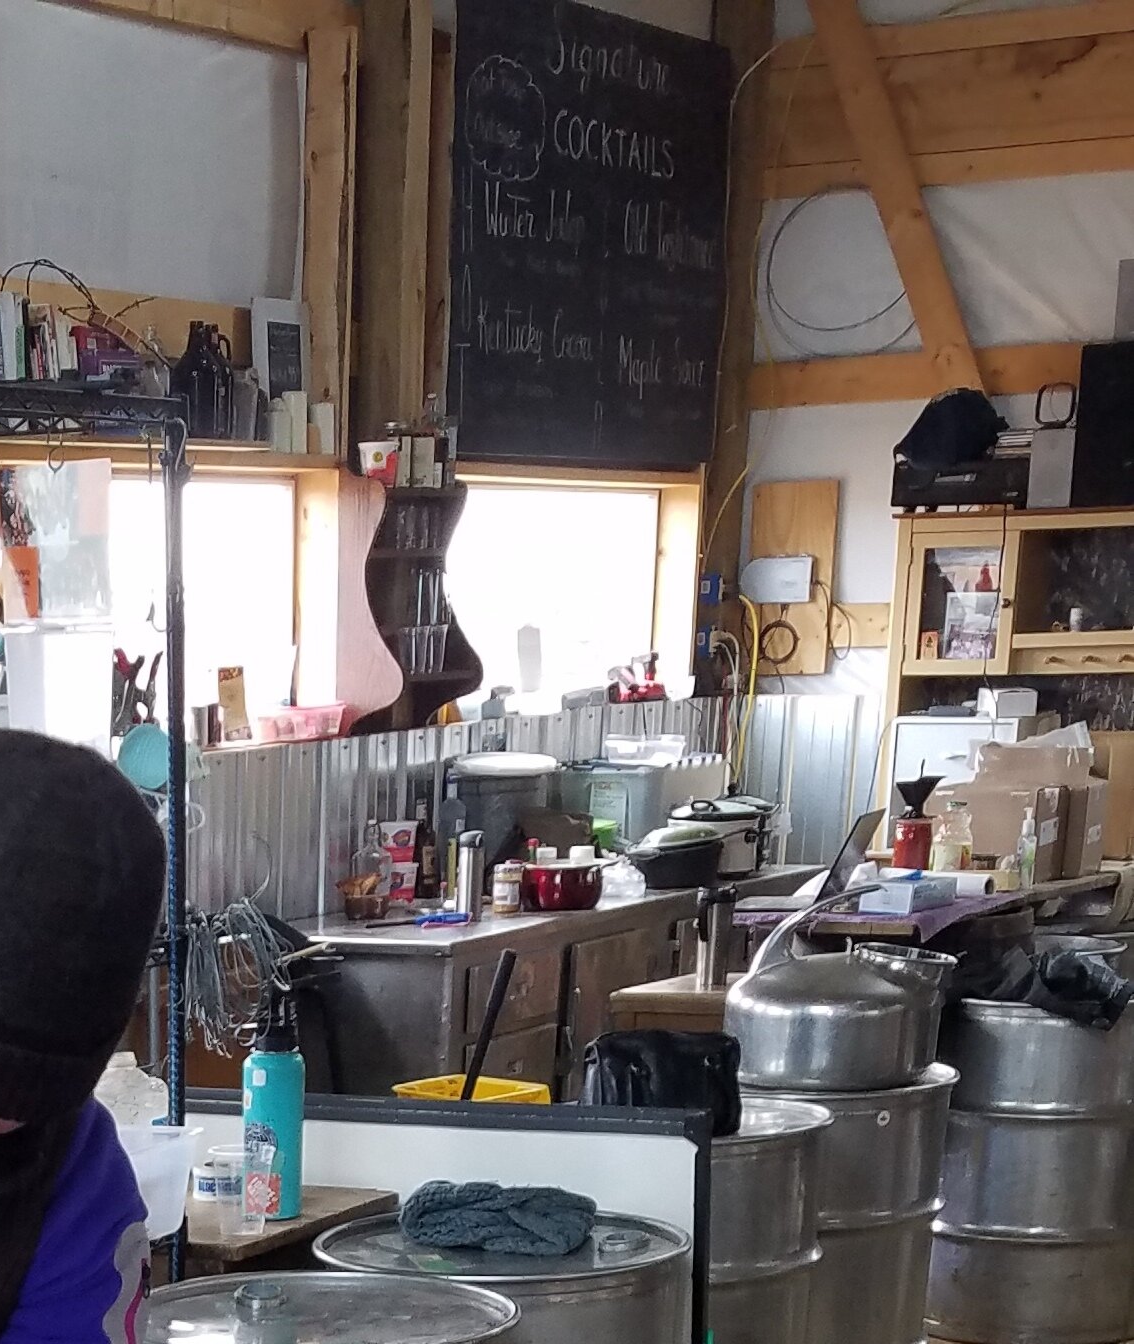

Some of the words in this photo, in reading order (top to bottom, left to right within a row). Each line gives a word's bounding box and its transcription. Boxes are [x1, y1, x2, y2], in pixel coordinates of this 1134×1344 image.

[553, 109, 675, 179] COCKTAILS
[476, 296, 544, 365] Kentucky
[618, 334, 662, 401] Maple
